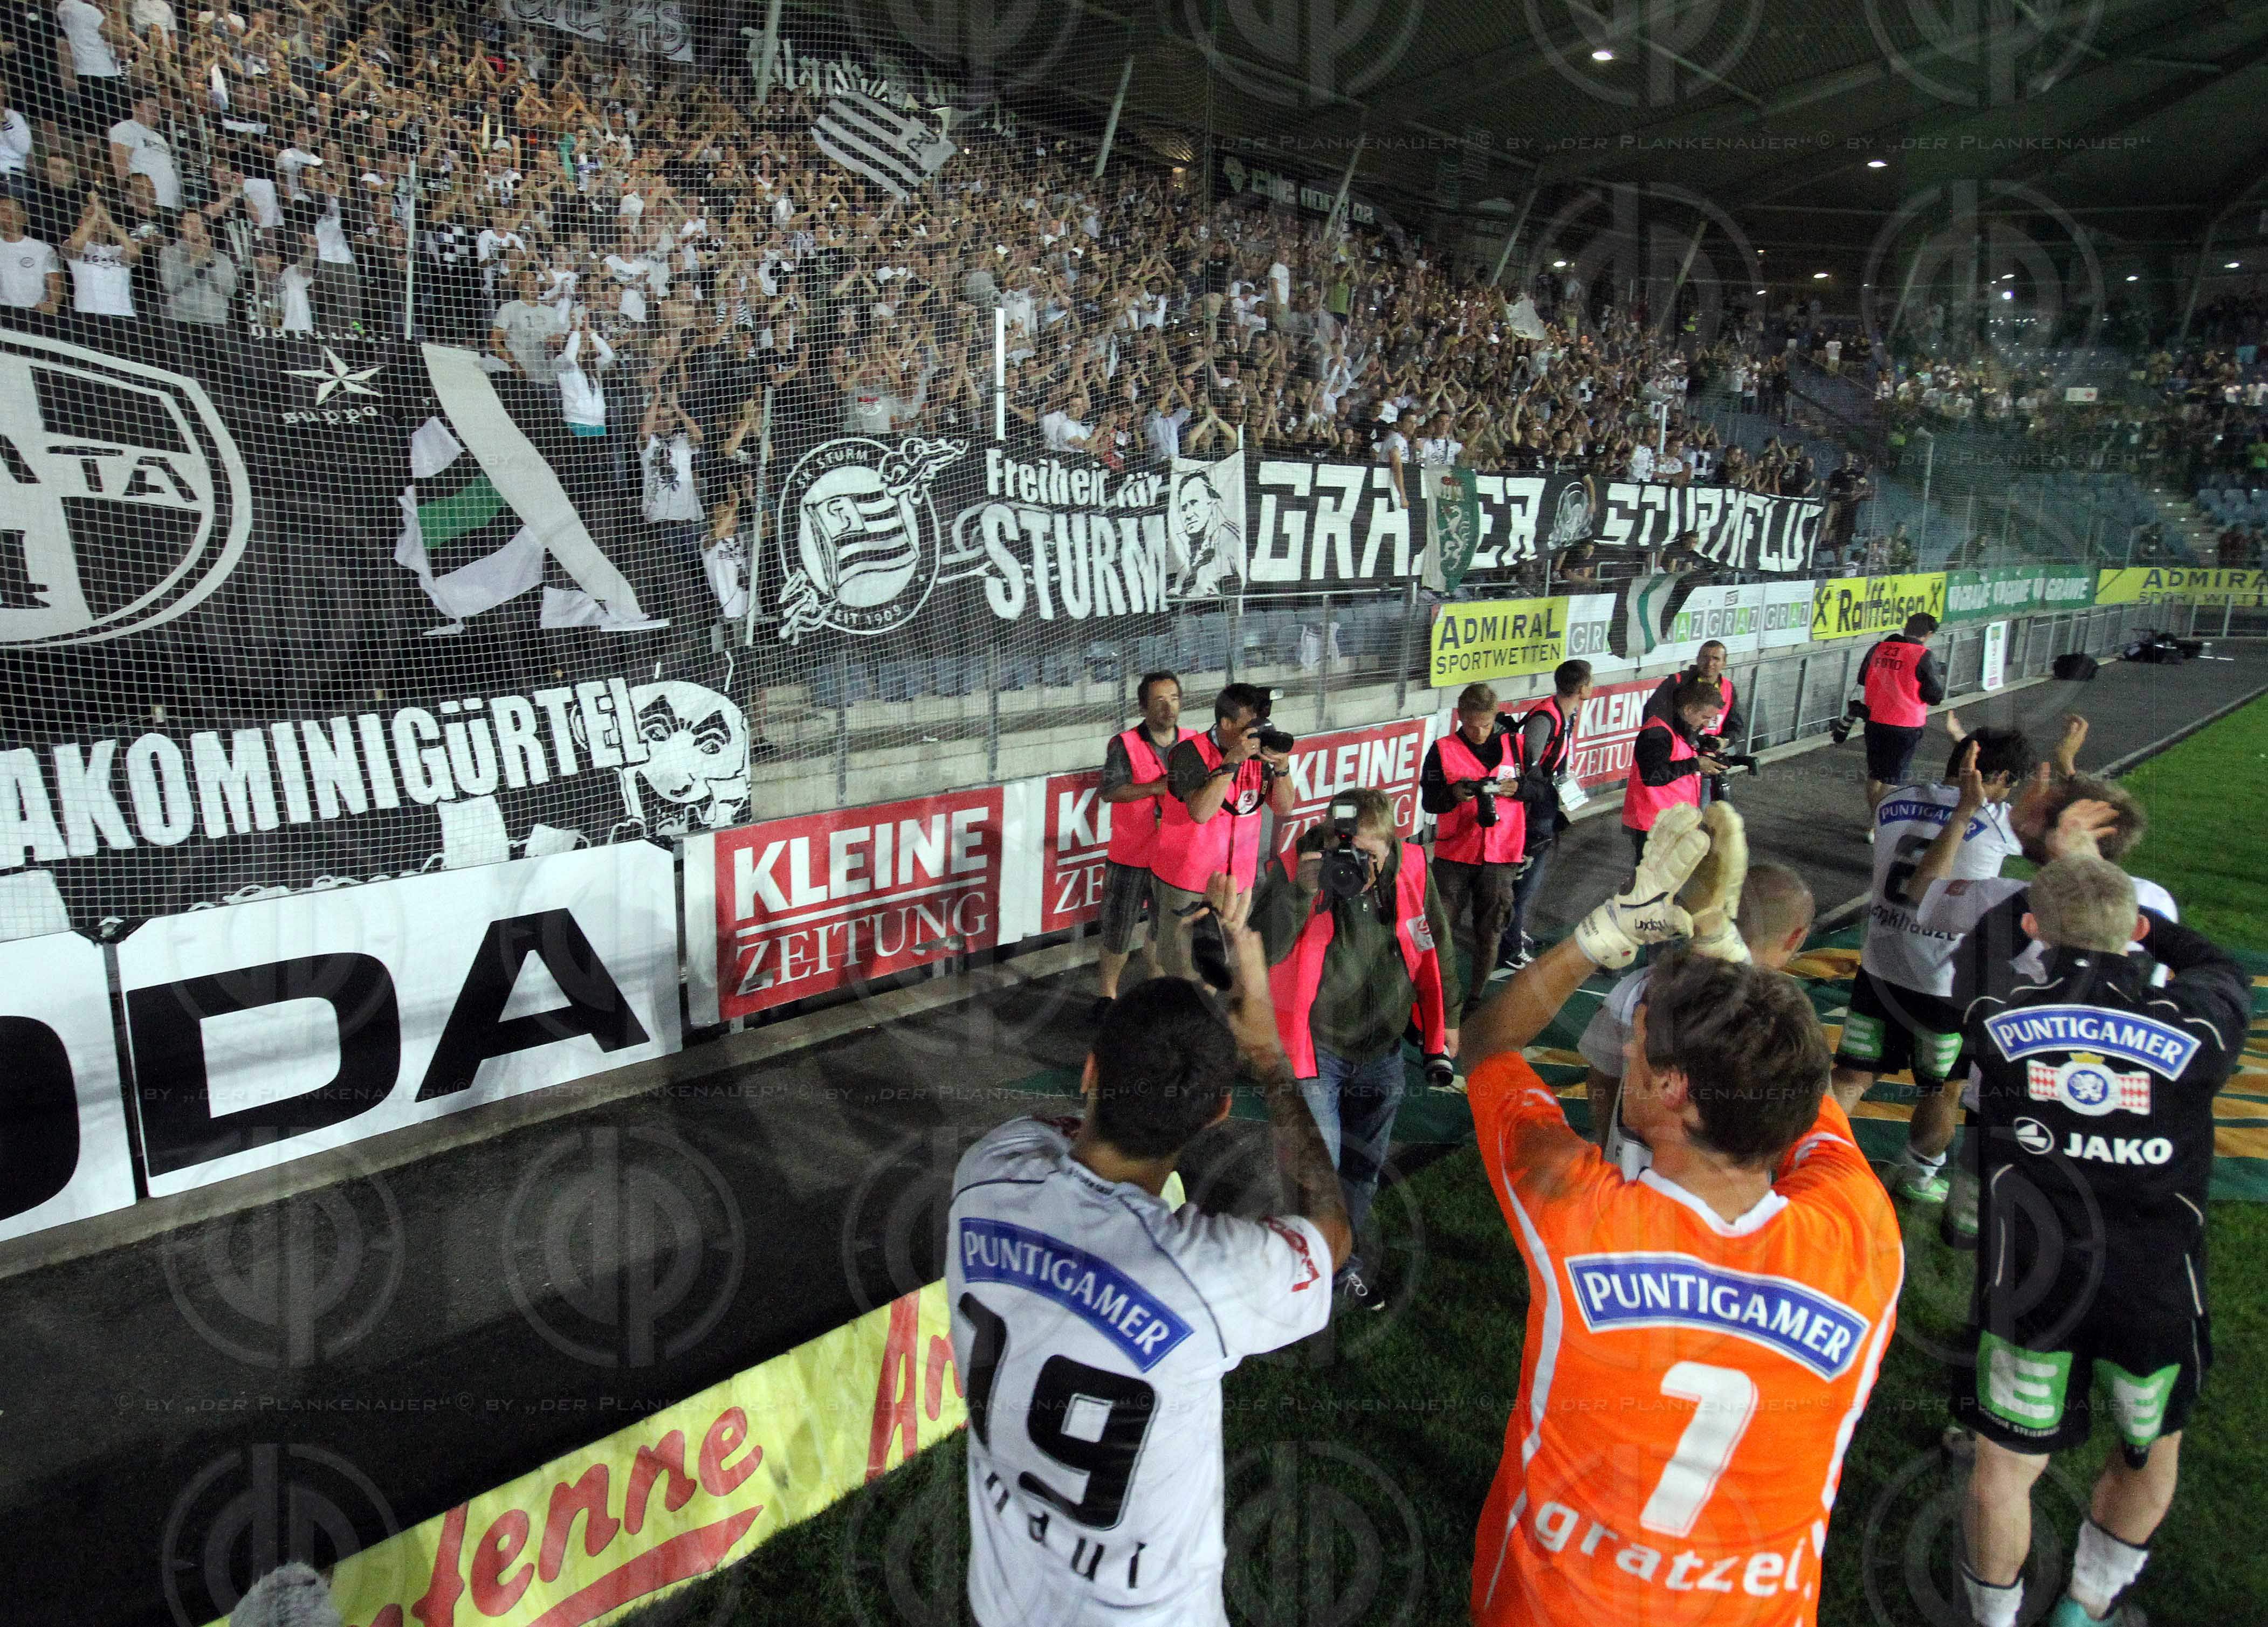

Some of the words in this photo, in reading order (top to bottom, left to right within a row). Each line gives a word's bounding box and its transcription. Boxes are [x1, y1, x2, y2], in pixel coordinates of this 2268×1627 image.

[817, 449, 868, 468] STURM
[986, 449, 1110, 507] Freiheit
[1249, 461, 1546, 581] GRAER
[980, 504, 1170, 620] STURM
[866, 605, 903, 625] 1909
[1438, 608, 1561, 651] ADMIRAL
[1707, 606, 1758, 636] GRAZ
[1765, 601, 1808, 629] GRAZ
[1837, 582, 1925, 632] Raiffeisen
[1437, 643, 1561, 675] SPORTWETTEN
[1874, 658, 1903, 670] FOTO
[1884, 645, 1899, 657] 23
[1578, 690, 1654, 739] KLEIN
[1289, 732, 1418, 801] KLEINE
[1575, 739, 1634, 778] ZEITU
[734, 806, 989, 921] KLEINE
[734, 891, 988, 998] ZEITUNG
[1998, 1016, 2184, 1065] PUNTIGAMER
[2063, 1132, 2173, 1165] JAKO
[964, 1231, 1169, 1355] PUNTIGAMER
[1583, 1271, 1851, 1363] PUNTIGAMER
[958, 1291, 1162, 1532] 19
